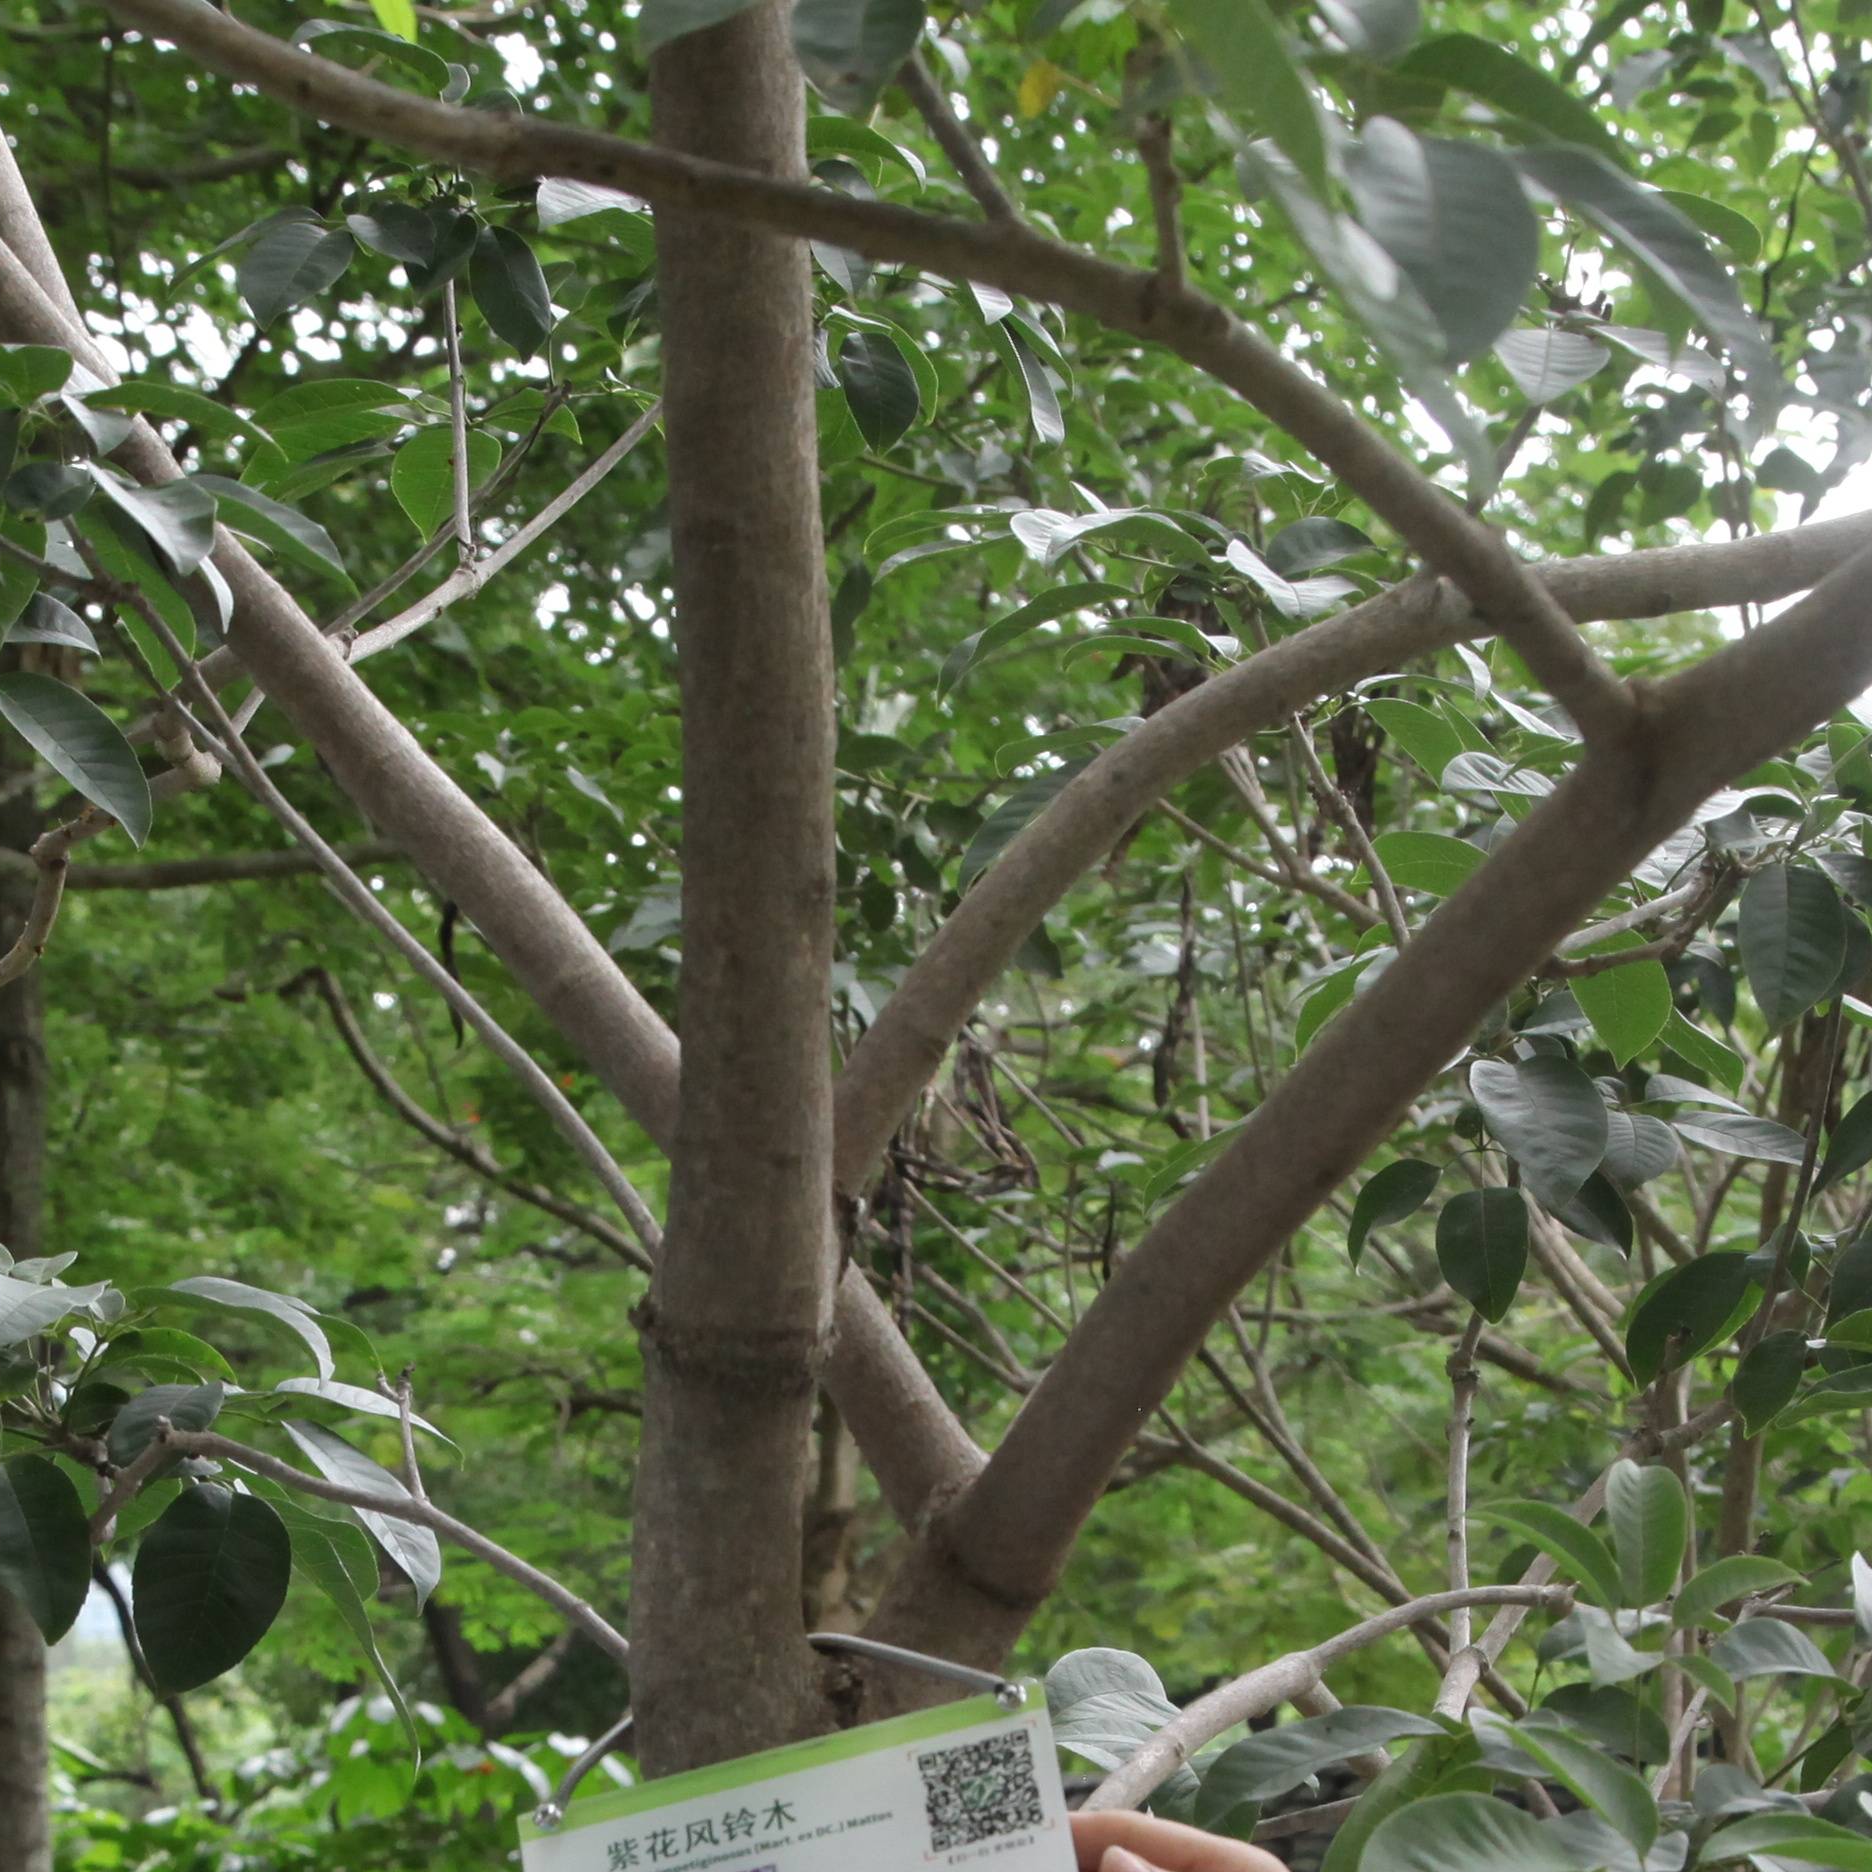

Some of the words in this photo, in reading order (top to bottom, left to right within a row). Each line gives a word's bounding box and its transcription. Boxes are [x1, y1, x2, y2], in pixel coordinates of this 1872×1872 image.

[607, 1798, 796, 1872] 紫花风铃木
